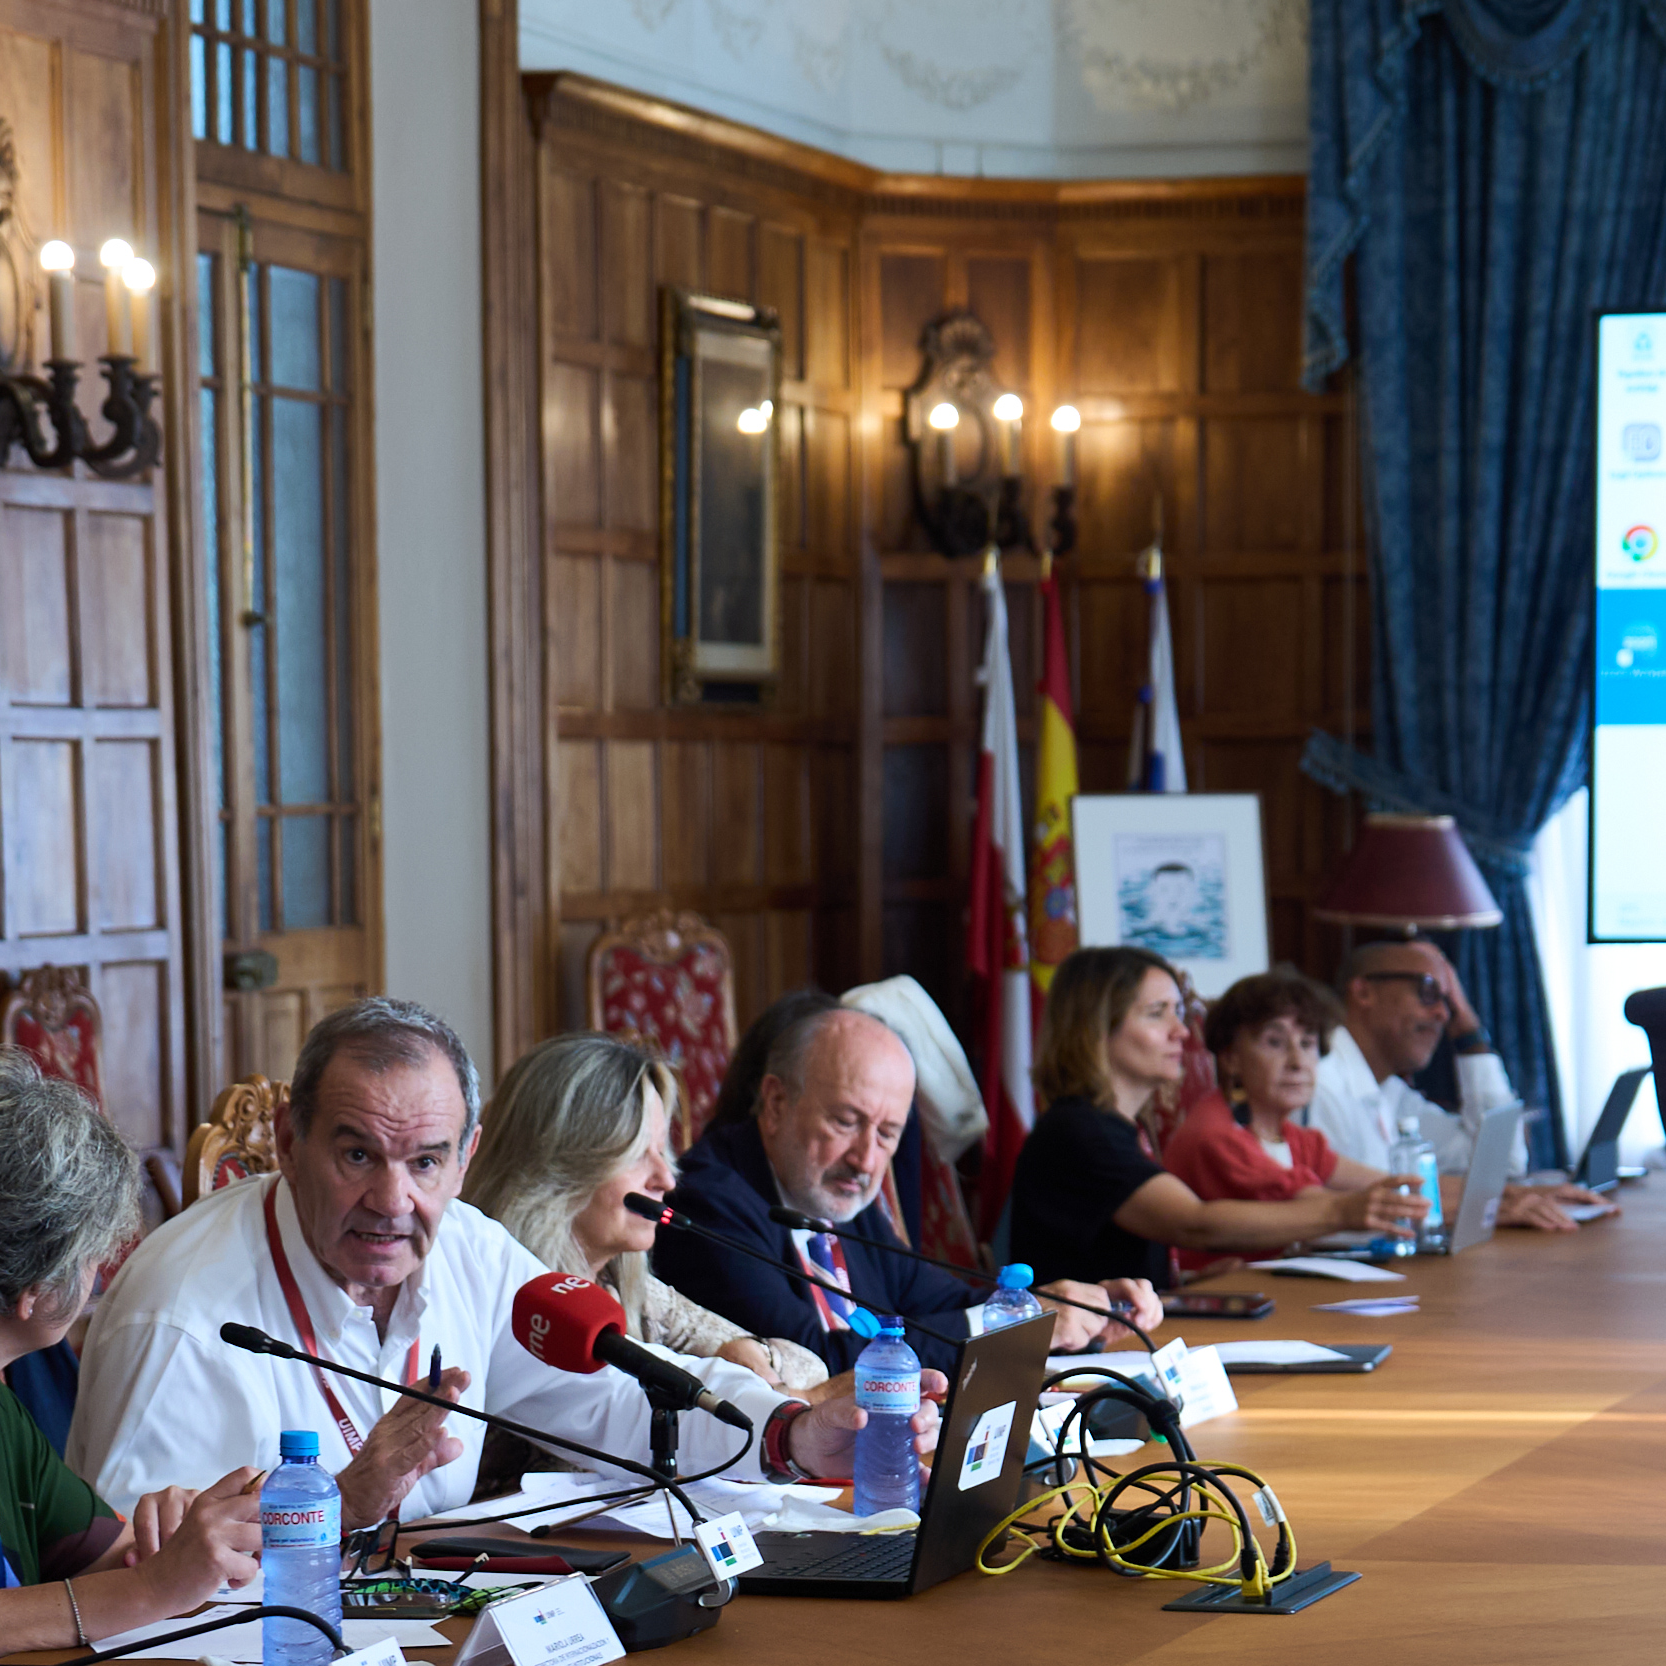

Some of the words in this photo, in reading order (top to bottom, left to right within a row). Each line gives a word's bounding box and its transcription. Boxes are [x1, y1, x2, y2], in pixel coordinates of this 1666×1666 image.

[529, 1313, 551, 1360] rne
[863, 1380, 917, 1393] CORCONTE
[262, 1510, 325, 1526] CORCONTE
